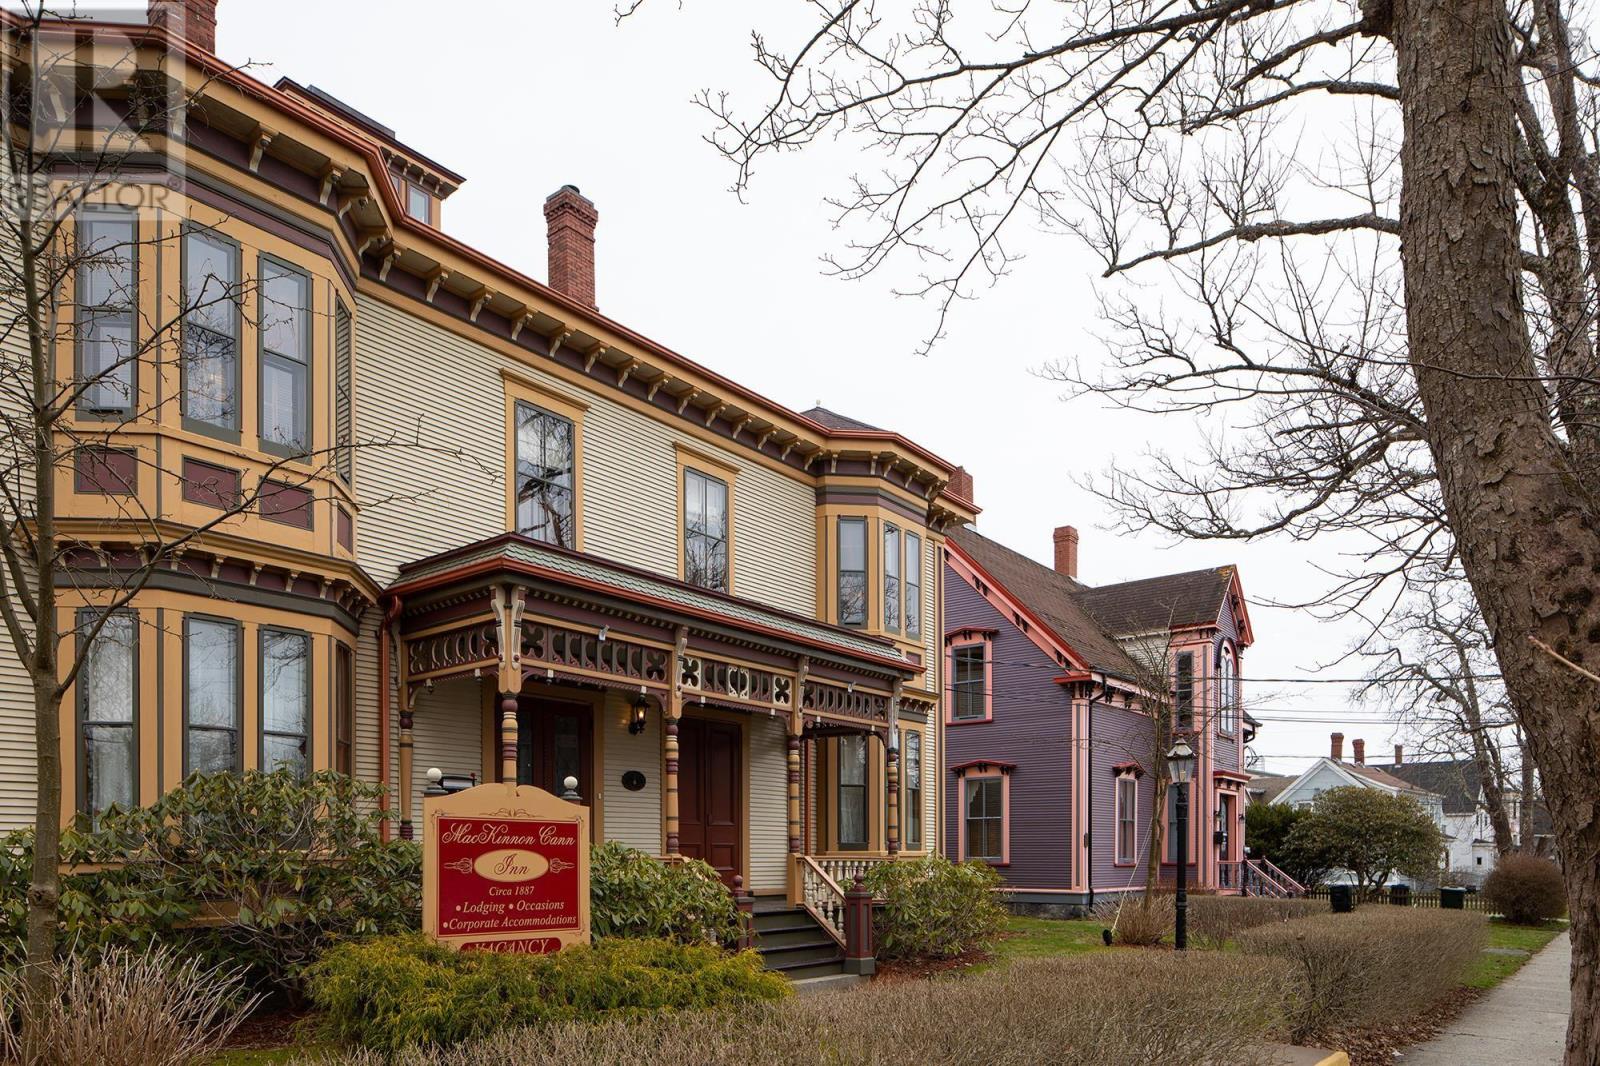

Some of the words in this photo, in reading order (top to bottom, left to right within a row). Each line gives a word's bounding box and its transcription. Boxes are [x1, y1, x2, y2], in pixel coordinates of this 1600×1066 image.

[442, 823, 536, 845] MacKinnon
[538, 826, 575, 846] Cann
[494, 853, 529, 875] Inn
[488, 886, 512, 896] Circa
[515, 885, 535, 896] 1887
[463, 901, 505, 914] Lodging
[516, 899, 565, 911] Occasions
[449, 918, 499, 932] Corporate
[501, 914, 577, 927] Accommodations
